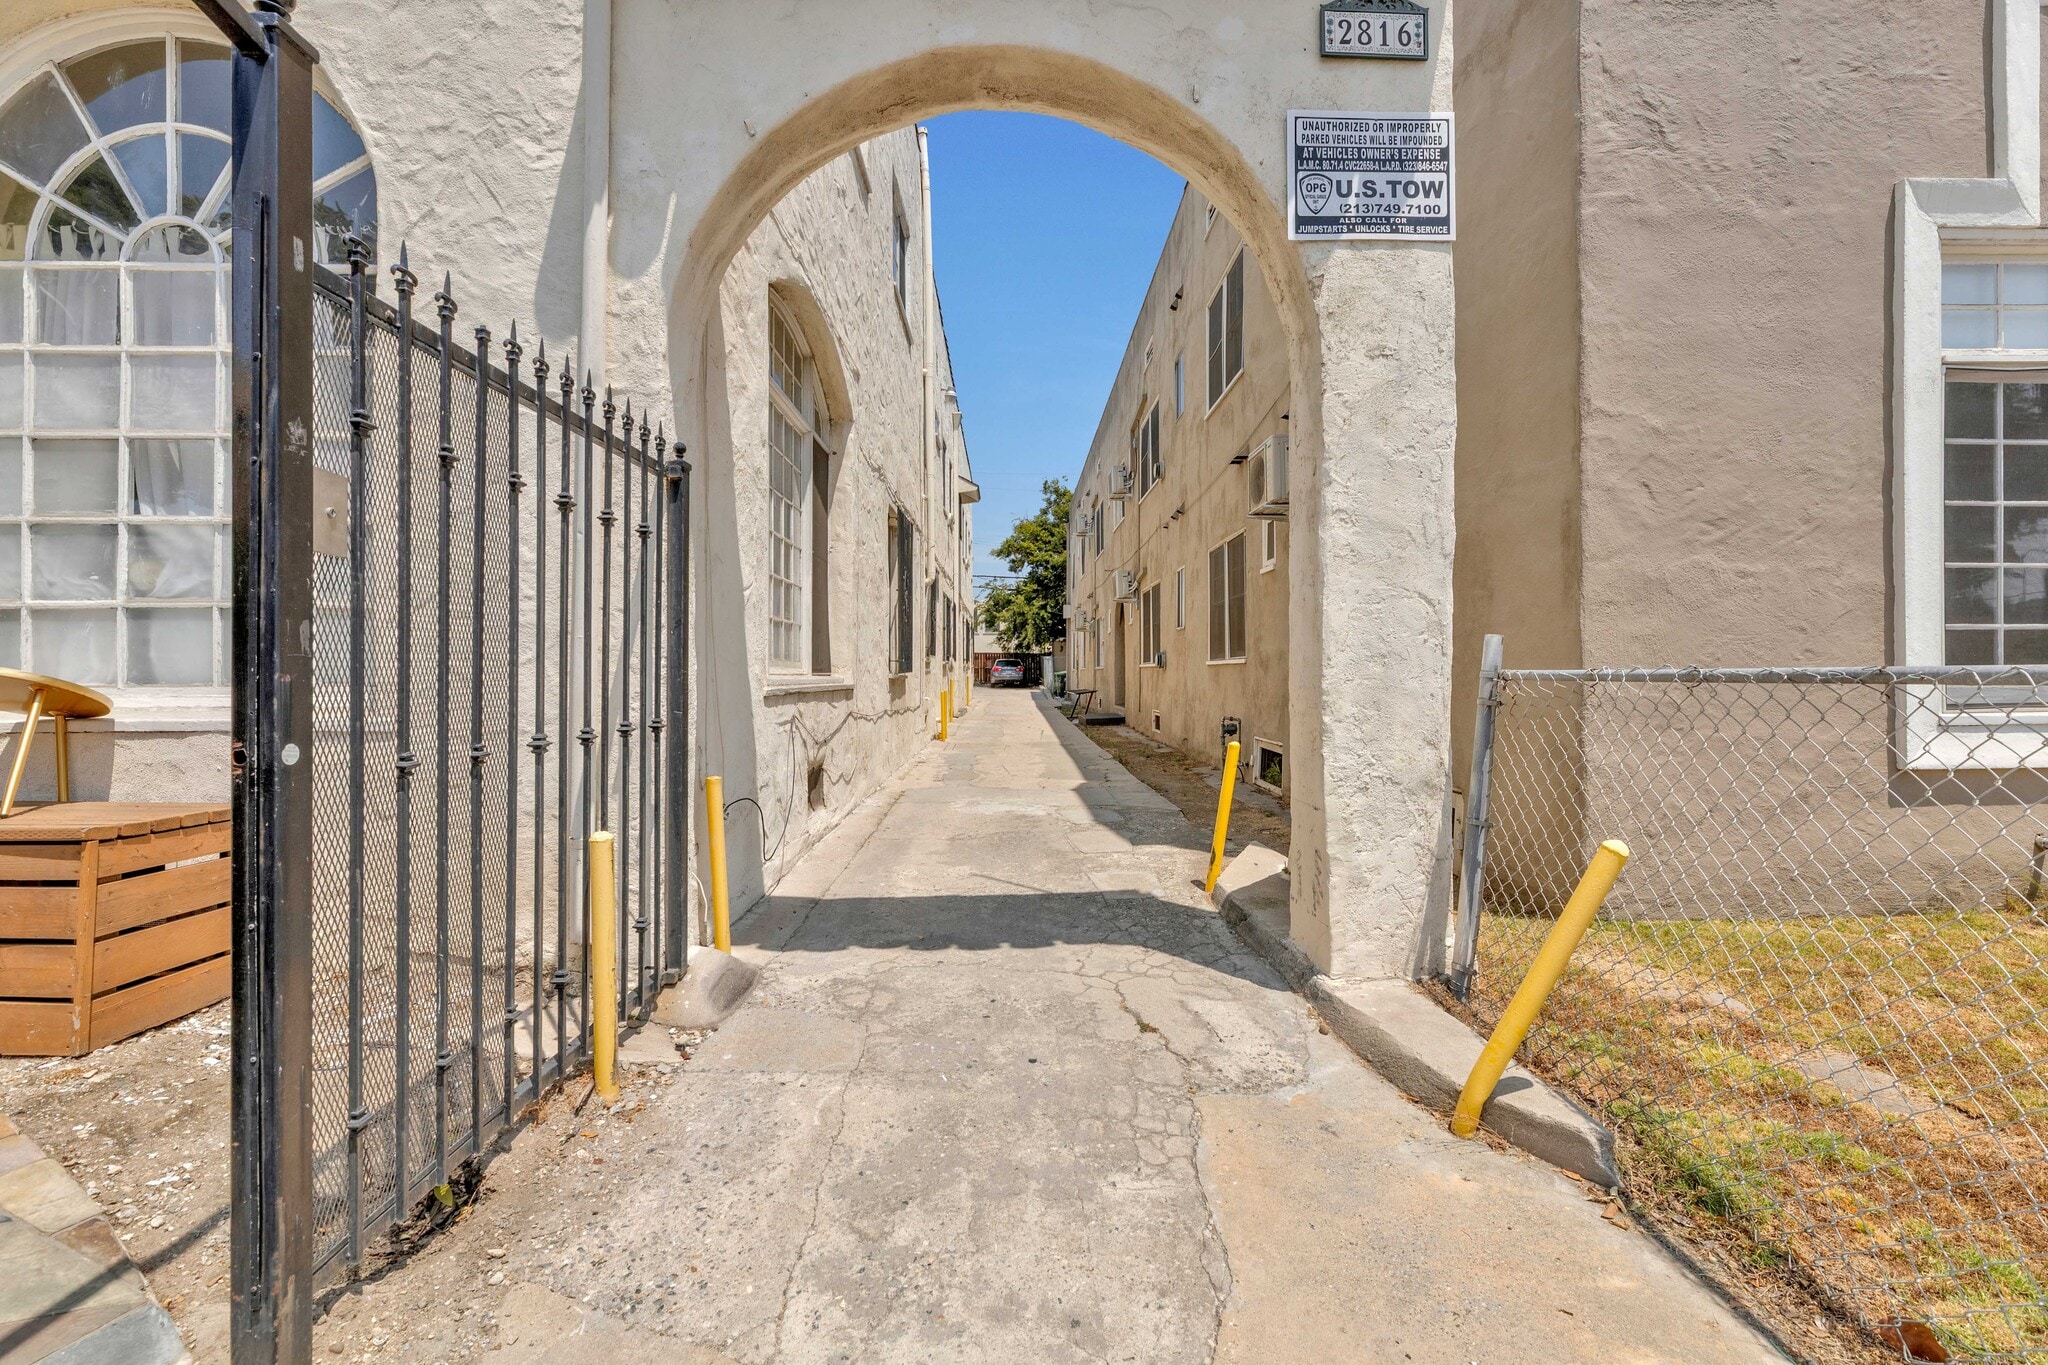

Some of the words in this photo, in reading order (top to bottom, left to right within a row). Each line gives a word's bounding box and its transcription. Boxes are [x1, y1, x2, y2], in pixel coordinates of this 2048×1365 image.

[1338, 19, 1412, 47] 2816
[1302, 121, 1370, 132] UNAUTHORIZED
[1372, 122, 1383, 132] OR
[1387, 123, 1441, 133] IMPROPERLY
[1302, 134, 1330, 144] PARKED
[1332, 135, 1367, 145] VEHICLES
[1370, 135, 1386, 145] WILL
[1389, 136, 1397, 145] BE
[1400, 136, 1442, 145] IMPOUNDED
[1302, 148, 1314, 158] AT
[1317, 148, 1358, 159] VEHICLES
[1361, 149, 1399, 159] OWNER'S
[1402, 149, 1440, 159] EXPENSE
[1306, 183, 1327, 193] OPG
[1339, 204, 1441, 214] (213)749.7100
[1298, 225, 1347, 233] JUMPSTARTS
[1355, 225, 1390, 233] UNLOCKS
[1416, 226, 1448, 234] SERVICE
